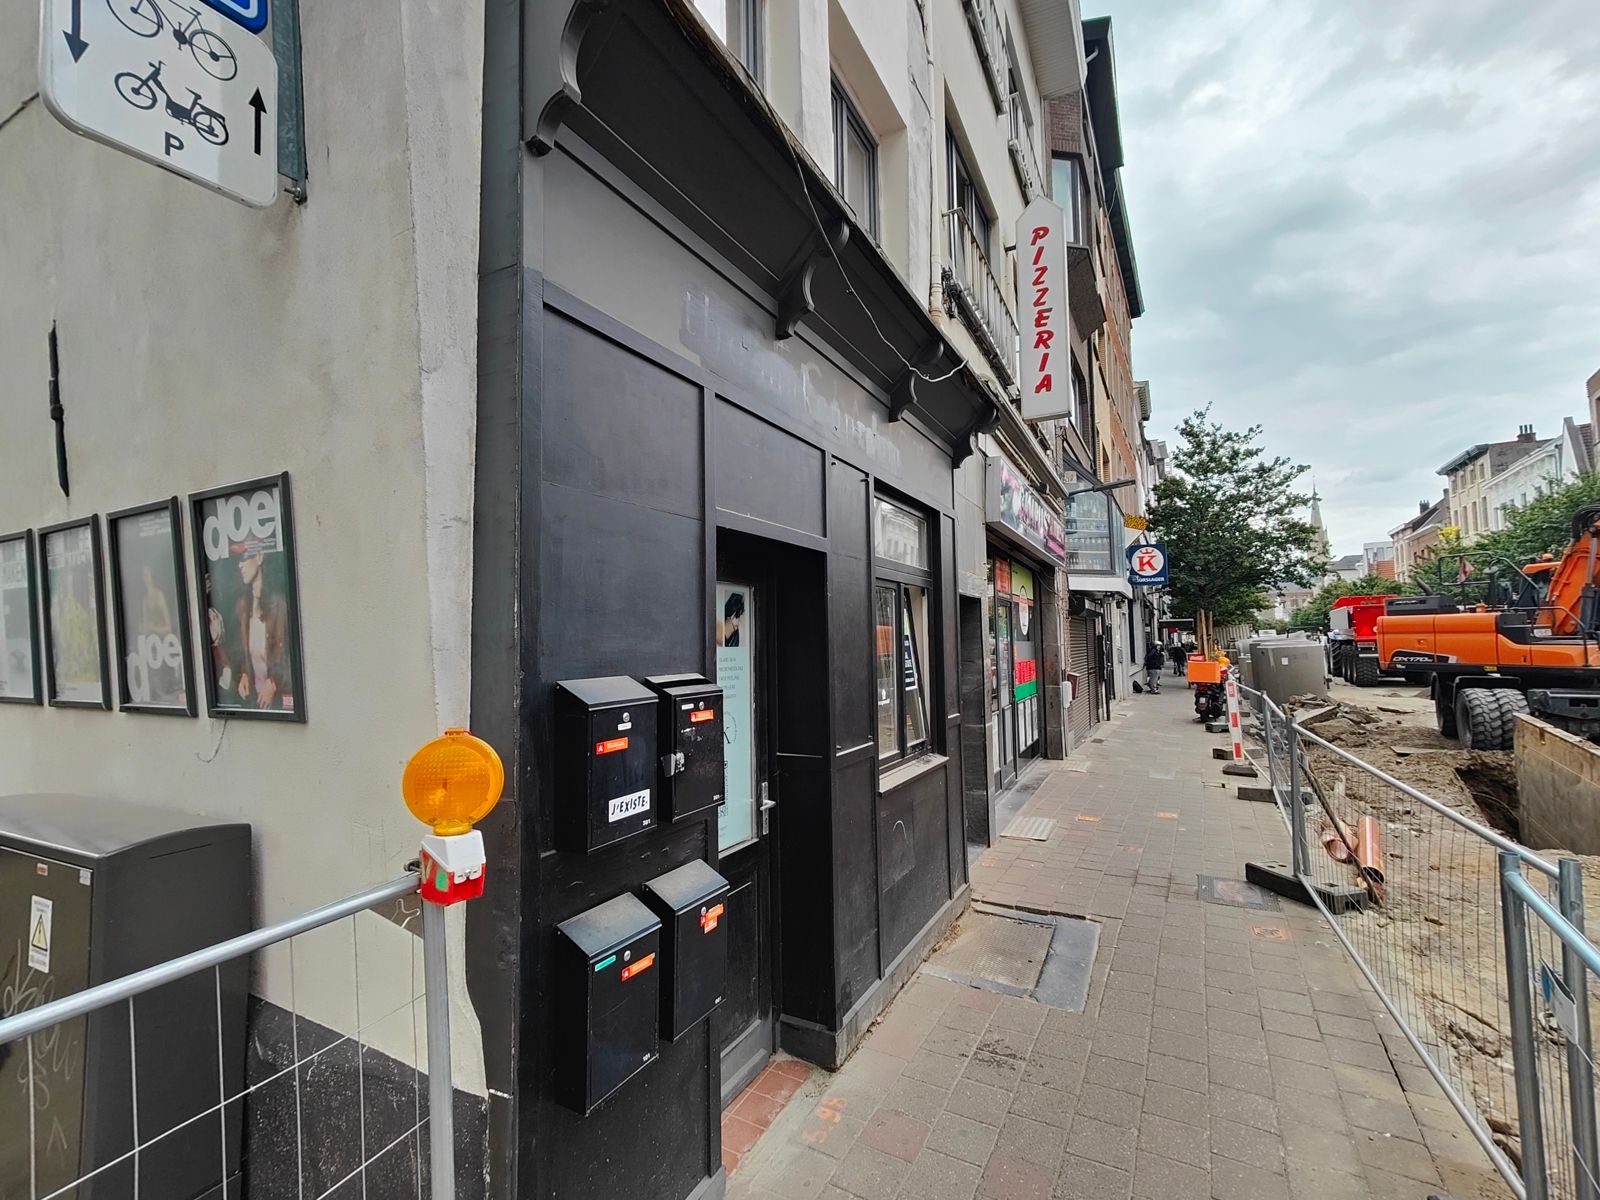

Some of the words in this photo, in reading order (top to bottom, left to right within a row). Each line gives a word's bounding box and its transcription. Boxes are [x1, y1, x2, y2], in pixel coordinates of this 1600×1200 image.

[164, 131, 184, 156] P
[1030, 225, 1055, 394] PIZZERIA
[1136, 554, 1158, 572] K
[611, 796, 649, 816] J'EXISTE.
